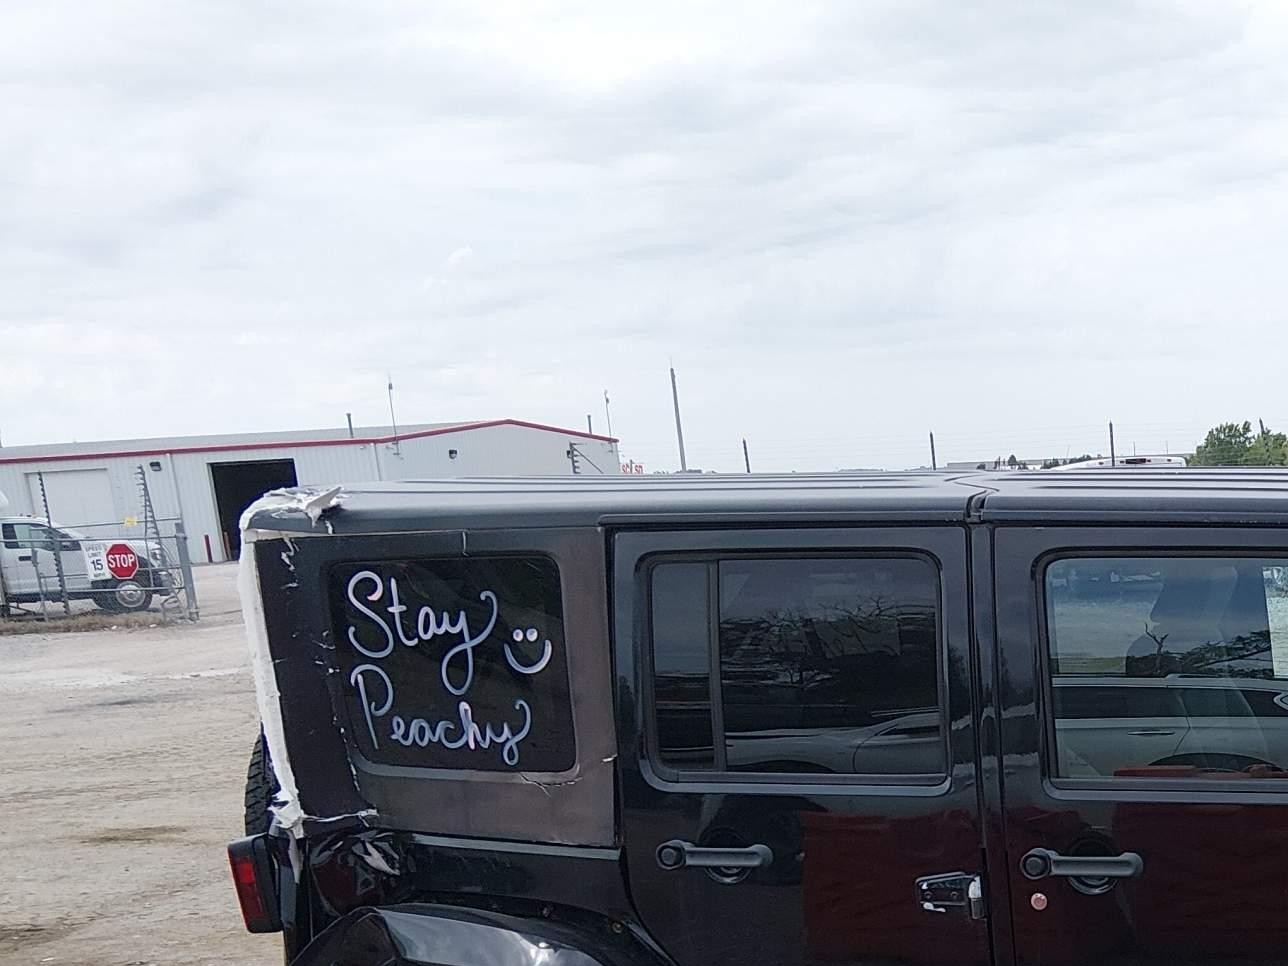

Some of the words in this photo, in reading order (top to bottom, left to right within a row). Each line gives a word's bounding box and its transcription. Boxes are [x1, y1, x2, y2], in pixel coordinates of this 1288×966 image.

[90, 559, 104, 571] 15
[108, 553, 135, 568] STOP
[347, 570, 498, 695] Stay
[350, 664, 531, 765] Peachy
